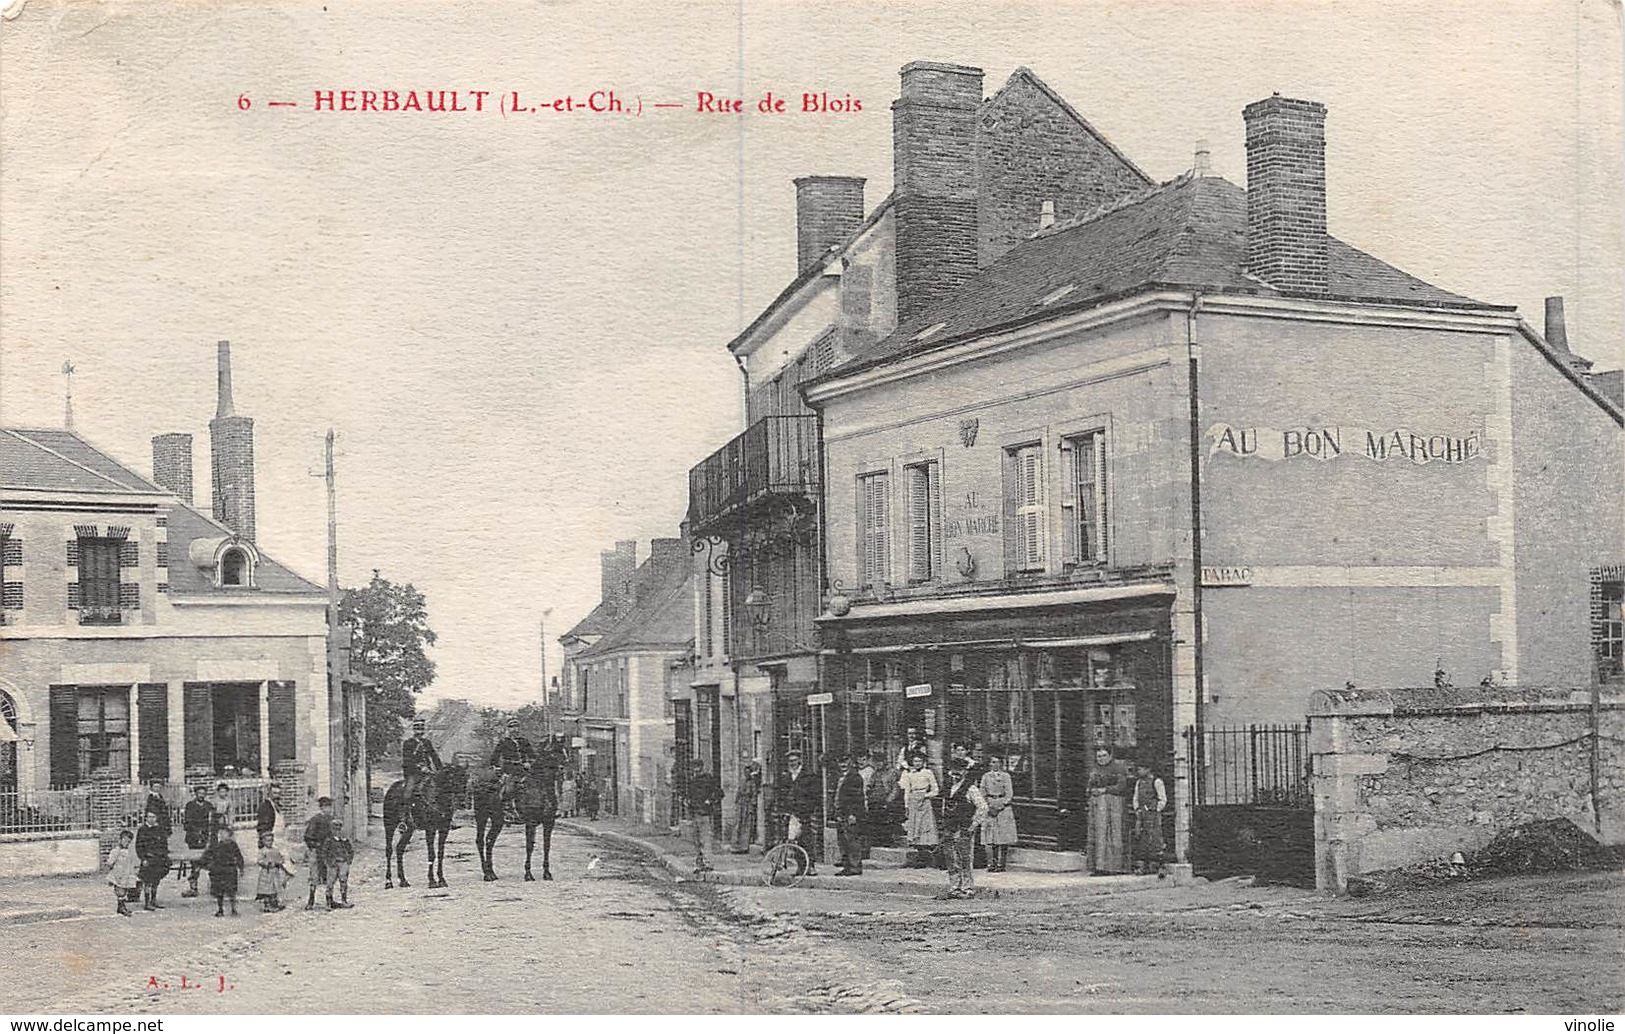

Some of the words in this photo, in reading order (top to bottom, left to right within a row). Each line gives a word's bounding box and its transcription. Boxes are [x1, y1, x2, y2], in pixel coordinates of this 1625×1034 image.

[1217, 425, 1258, 455] AU
[1283, 426, 1341, 459] BON
[1365, 429, 1481, 463] MARCHÉ
[1202, 567, 1250, 582] TABAC
